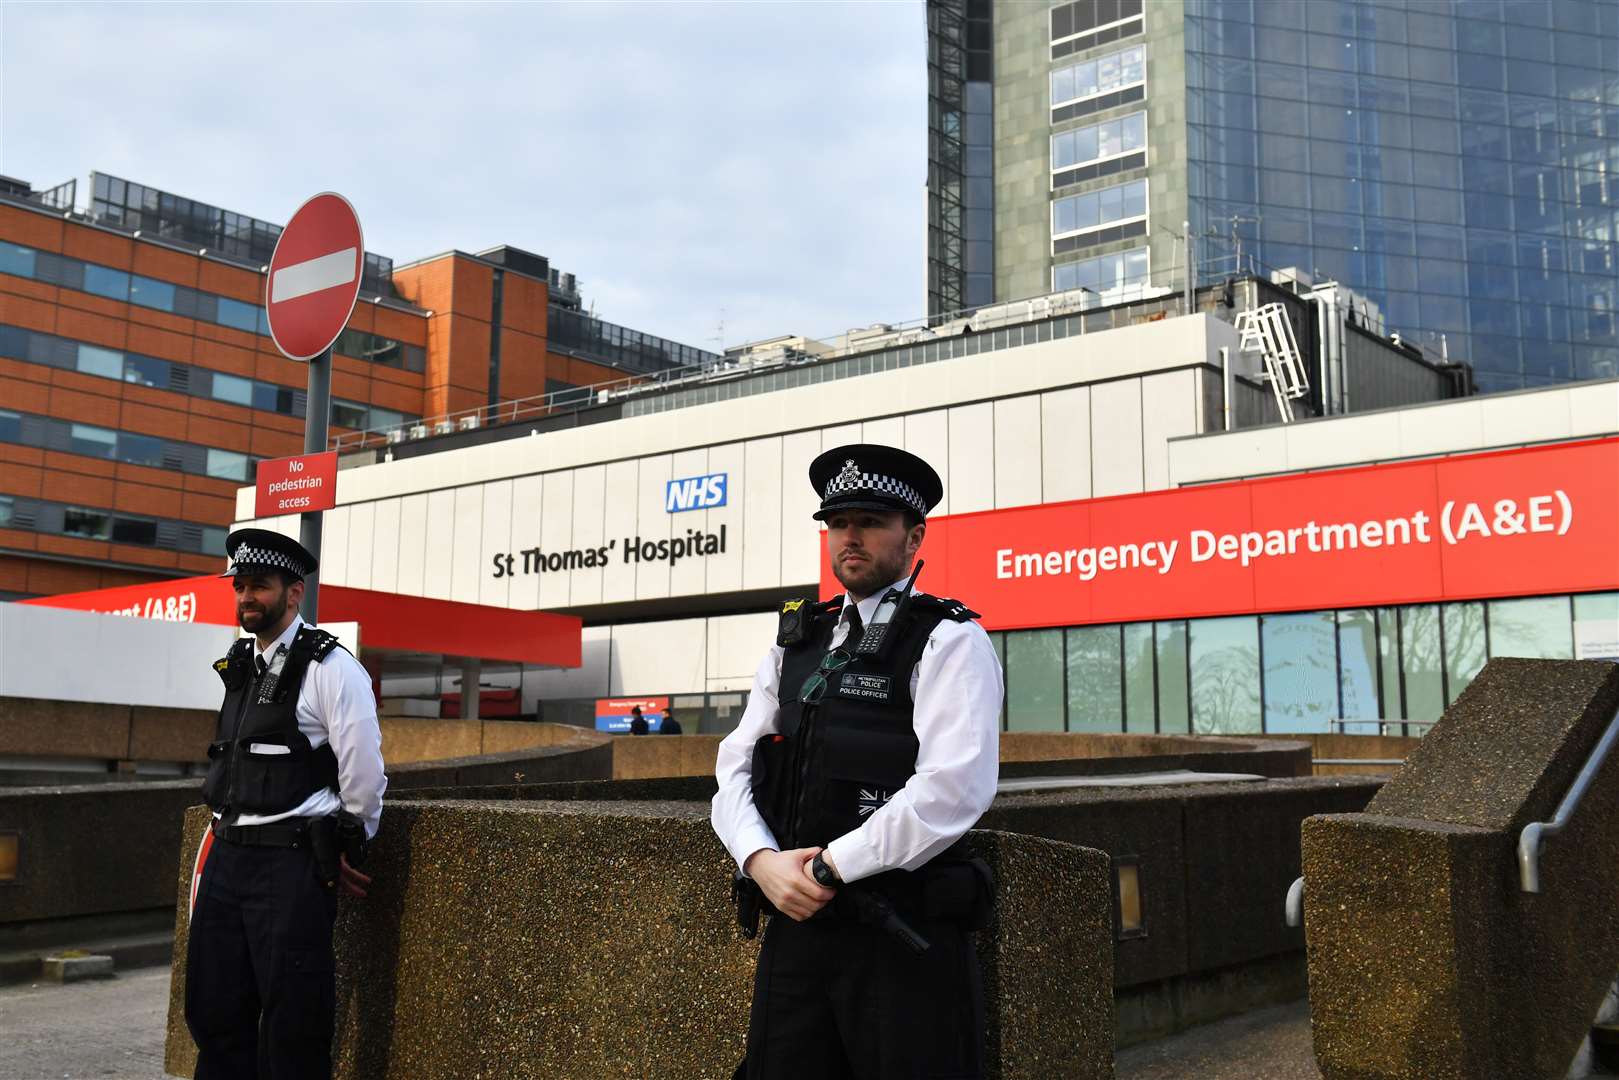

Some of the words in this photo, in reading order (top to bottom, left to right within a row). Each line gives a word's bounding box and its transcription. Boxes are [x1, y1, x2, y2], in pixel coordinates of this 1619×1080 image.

[289, 460, 304, 473] No
[268, 476, 322, 496] pedestrian
[666, 474, 726, 511] NHS
[279, 496, 310, 509] access
[996, 539, 1178, 581] Emergency
[1190, 510, 1431, 567] Department
[1440, 490, 1573, 545] (A&E)
[493, 552, 515, 578] St
[624, 524, 727, 567] Hospital
[144, 591, 197, 624] (A&E)
[861, 690, 888, 699] OFFICER
